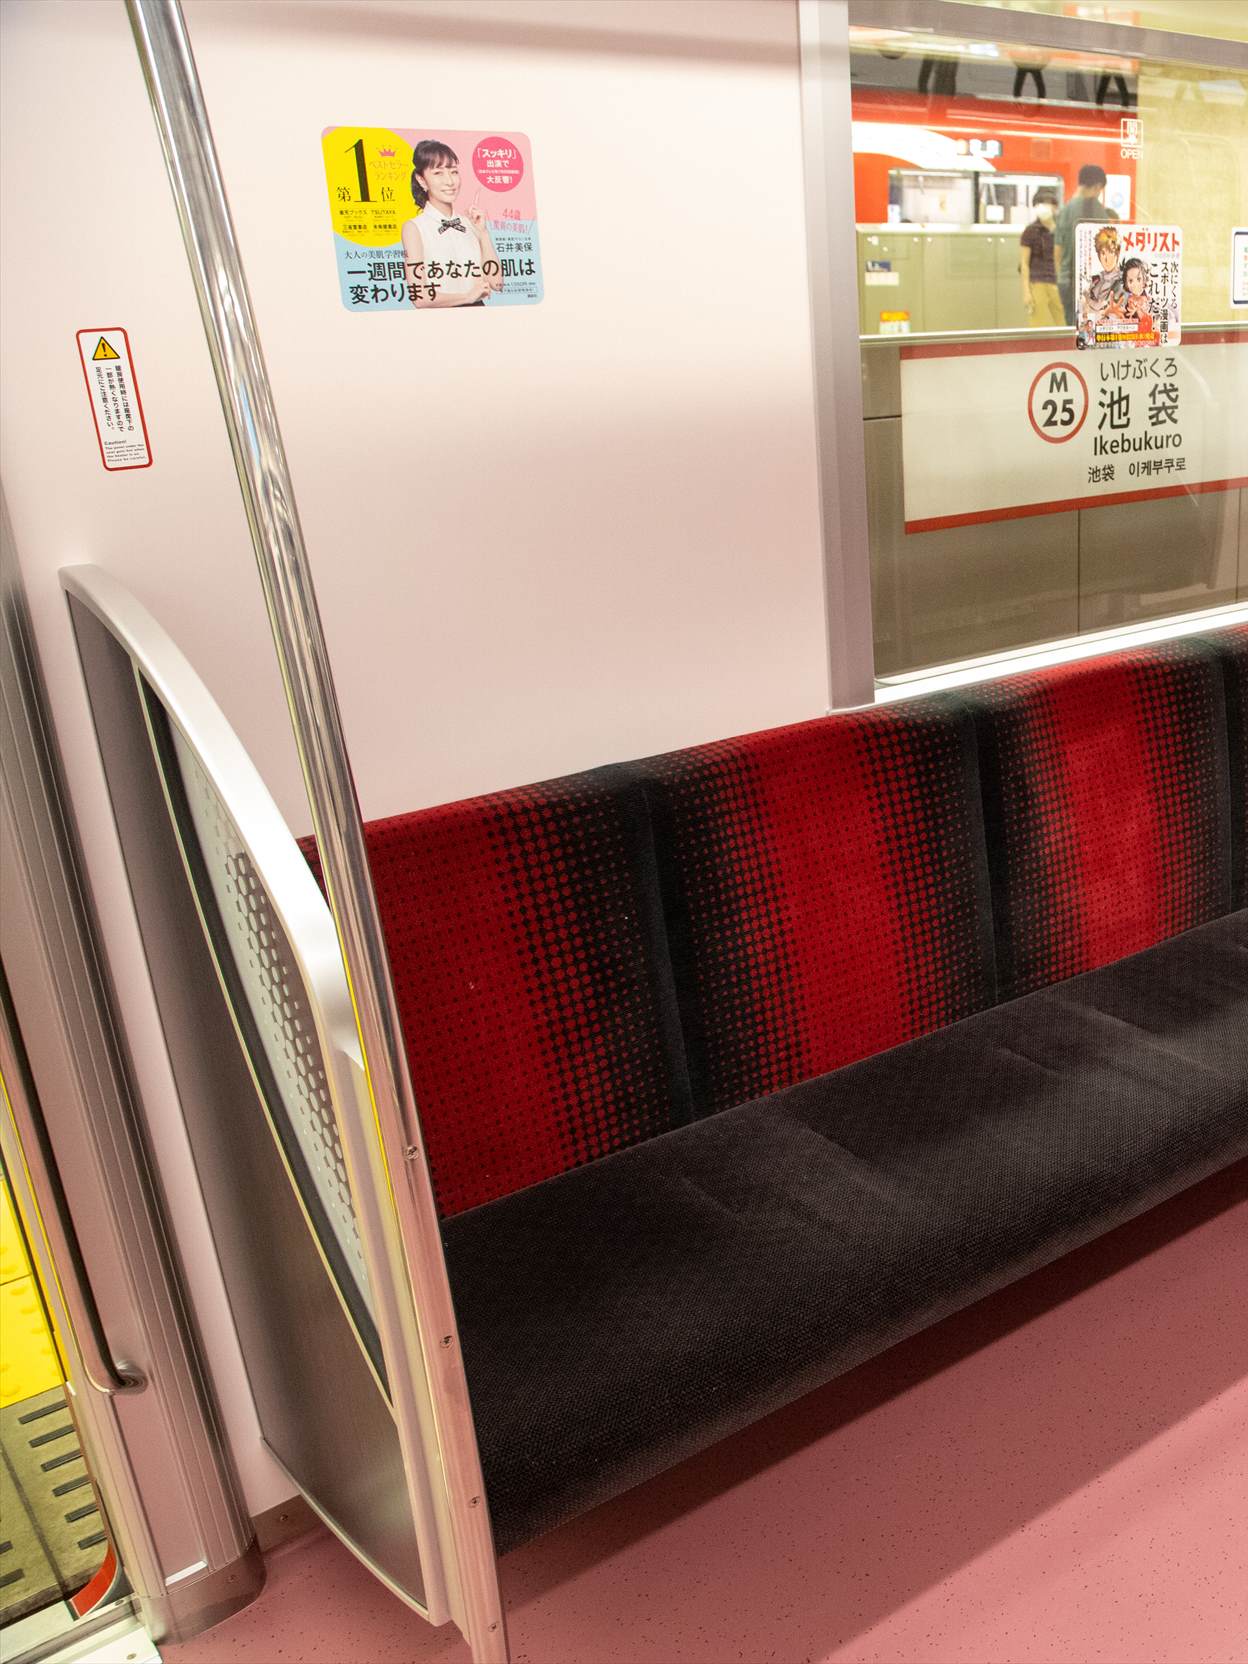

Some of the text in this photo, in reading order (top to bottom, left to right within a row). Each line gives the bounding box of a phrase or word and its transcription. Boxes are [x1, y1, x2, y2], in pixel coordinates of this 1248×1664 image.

[1120, 148, 1144, 160] OPEN
[495, 242, 533, 252] 石井美保
[1123, 227, 1180, 252] メダリスト
[347, 259, 536, 282] 一週間であなたの肌は
[349, 282, 441, 305] 変わります
[1170, 261, 1179, 310] 次にくる
[1160, 262, 1170, 343] スポーツ漫画は
[1100, 357, 1178, 381] いけぶくろ
[1049, 371, 1068, 393] M
[105, 367, 125, 432] 一部が熱くなりますので
[1098, 382, 1179, 431] 池袋
[1042, 399, 1075, 427] 25
[1093, 430, 1182, 456] Ikebukuro
[1088, 457, 1187, 483] 池袋 이케부쿠로
